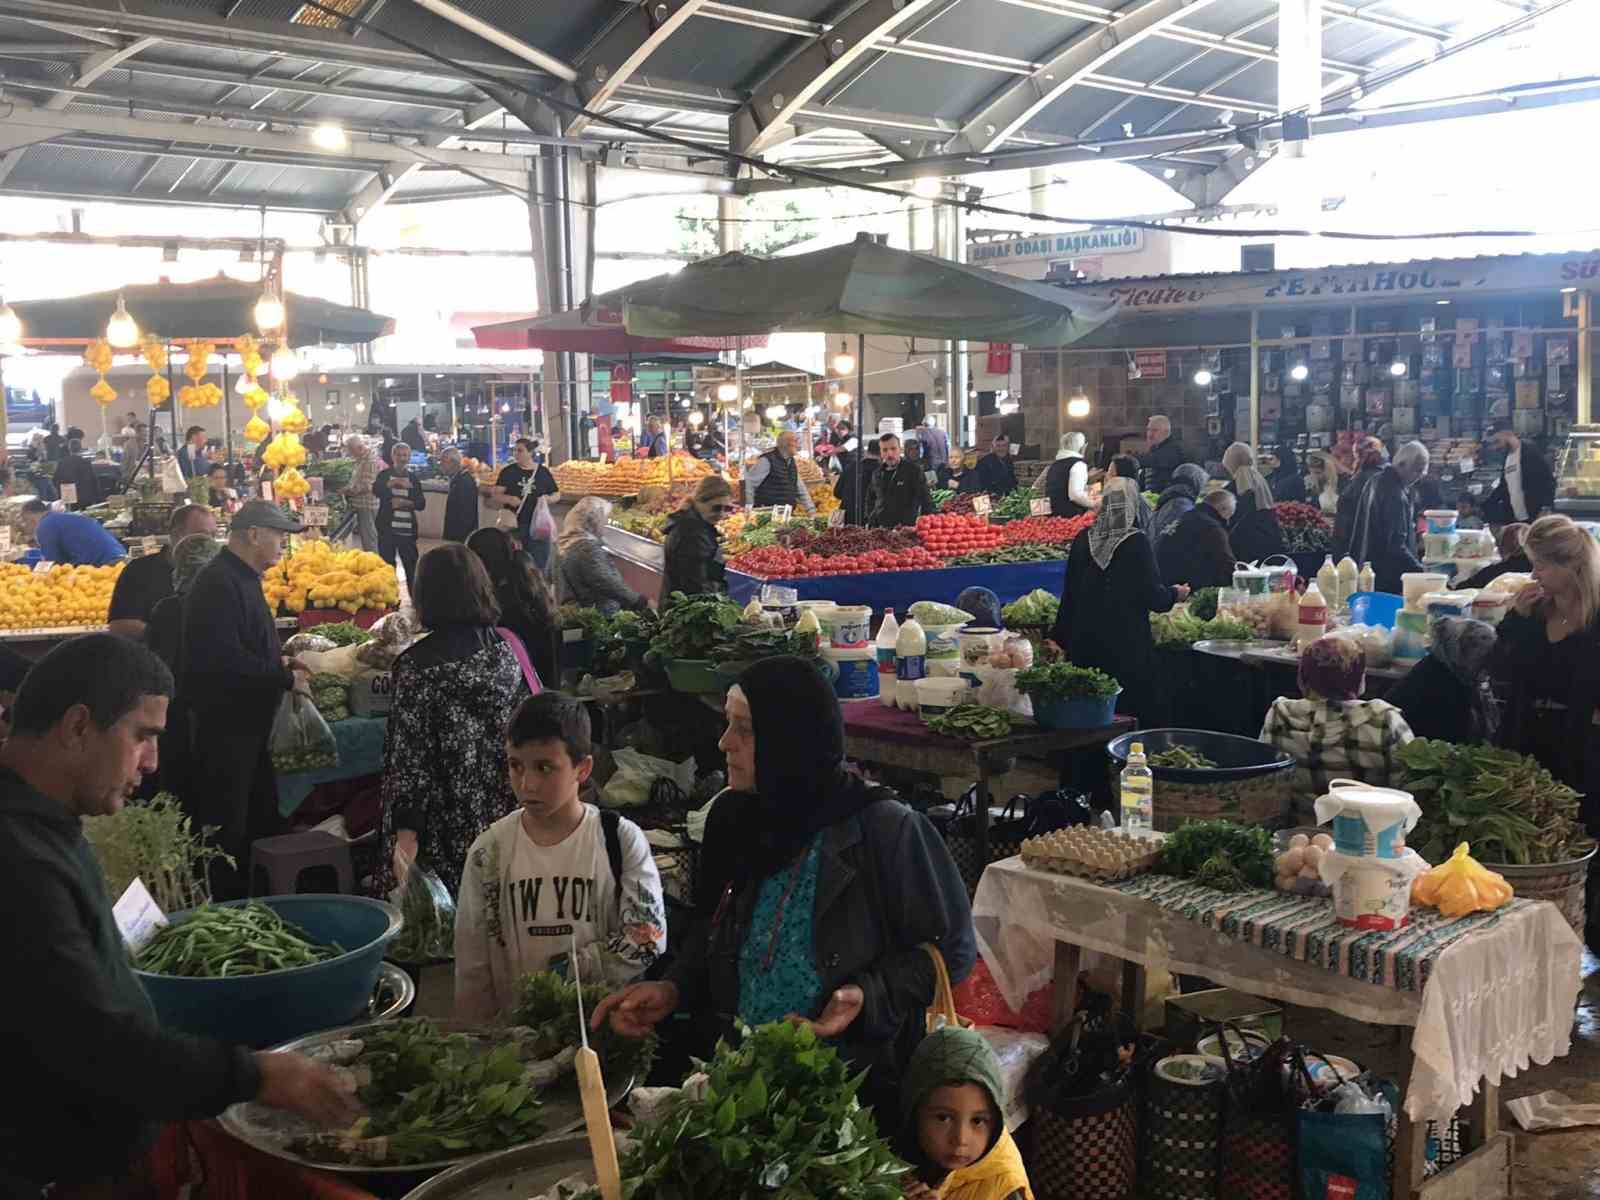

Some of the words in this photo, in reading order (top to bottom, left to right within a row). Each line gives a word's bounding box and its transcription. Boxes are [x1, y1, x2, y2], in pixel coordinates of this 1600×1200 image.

[1015, 239, 1052, 254] ODASI
[1056, 228, 1137, 252] BAŞKANLIĞI
[509, 876, 543, 922] W
